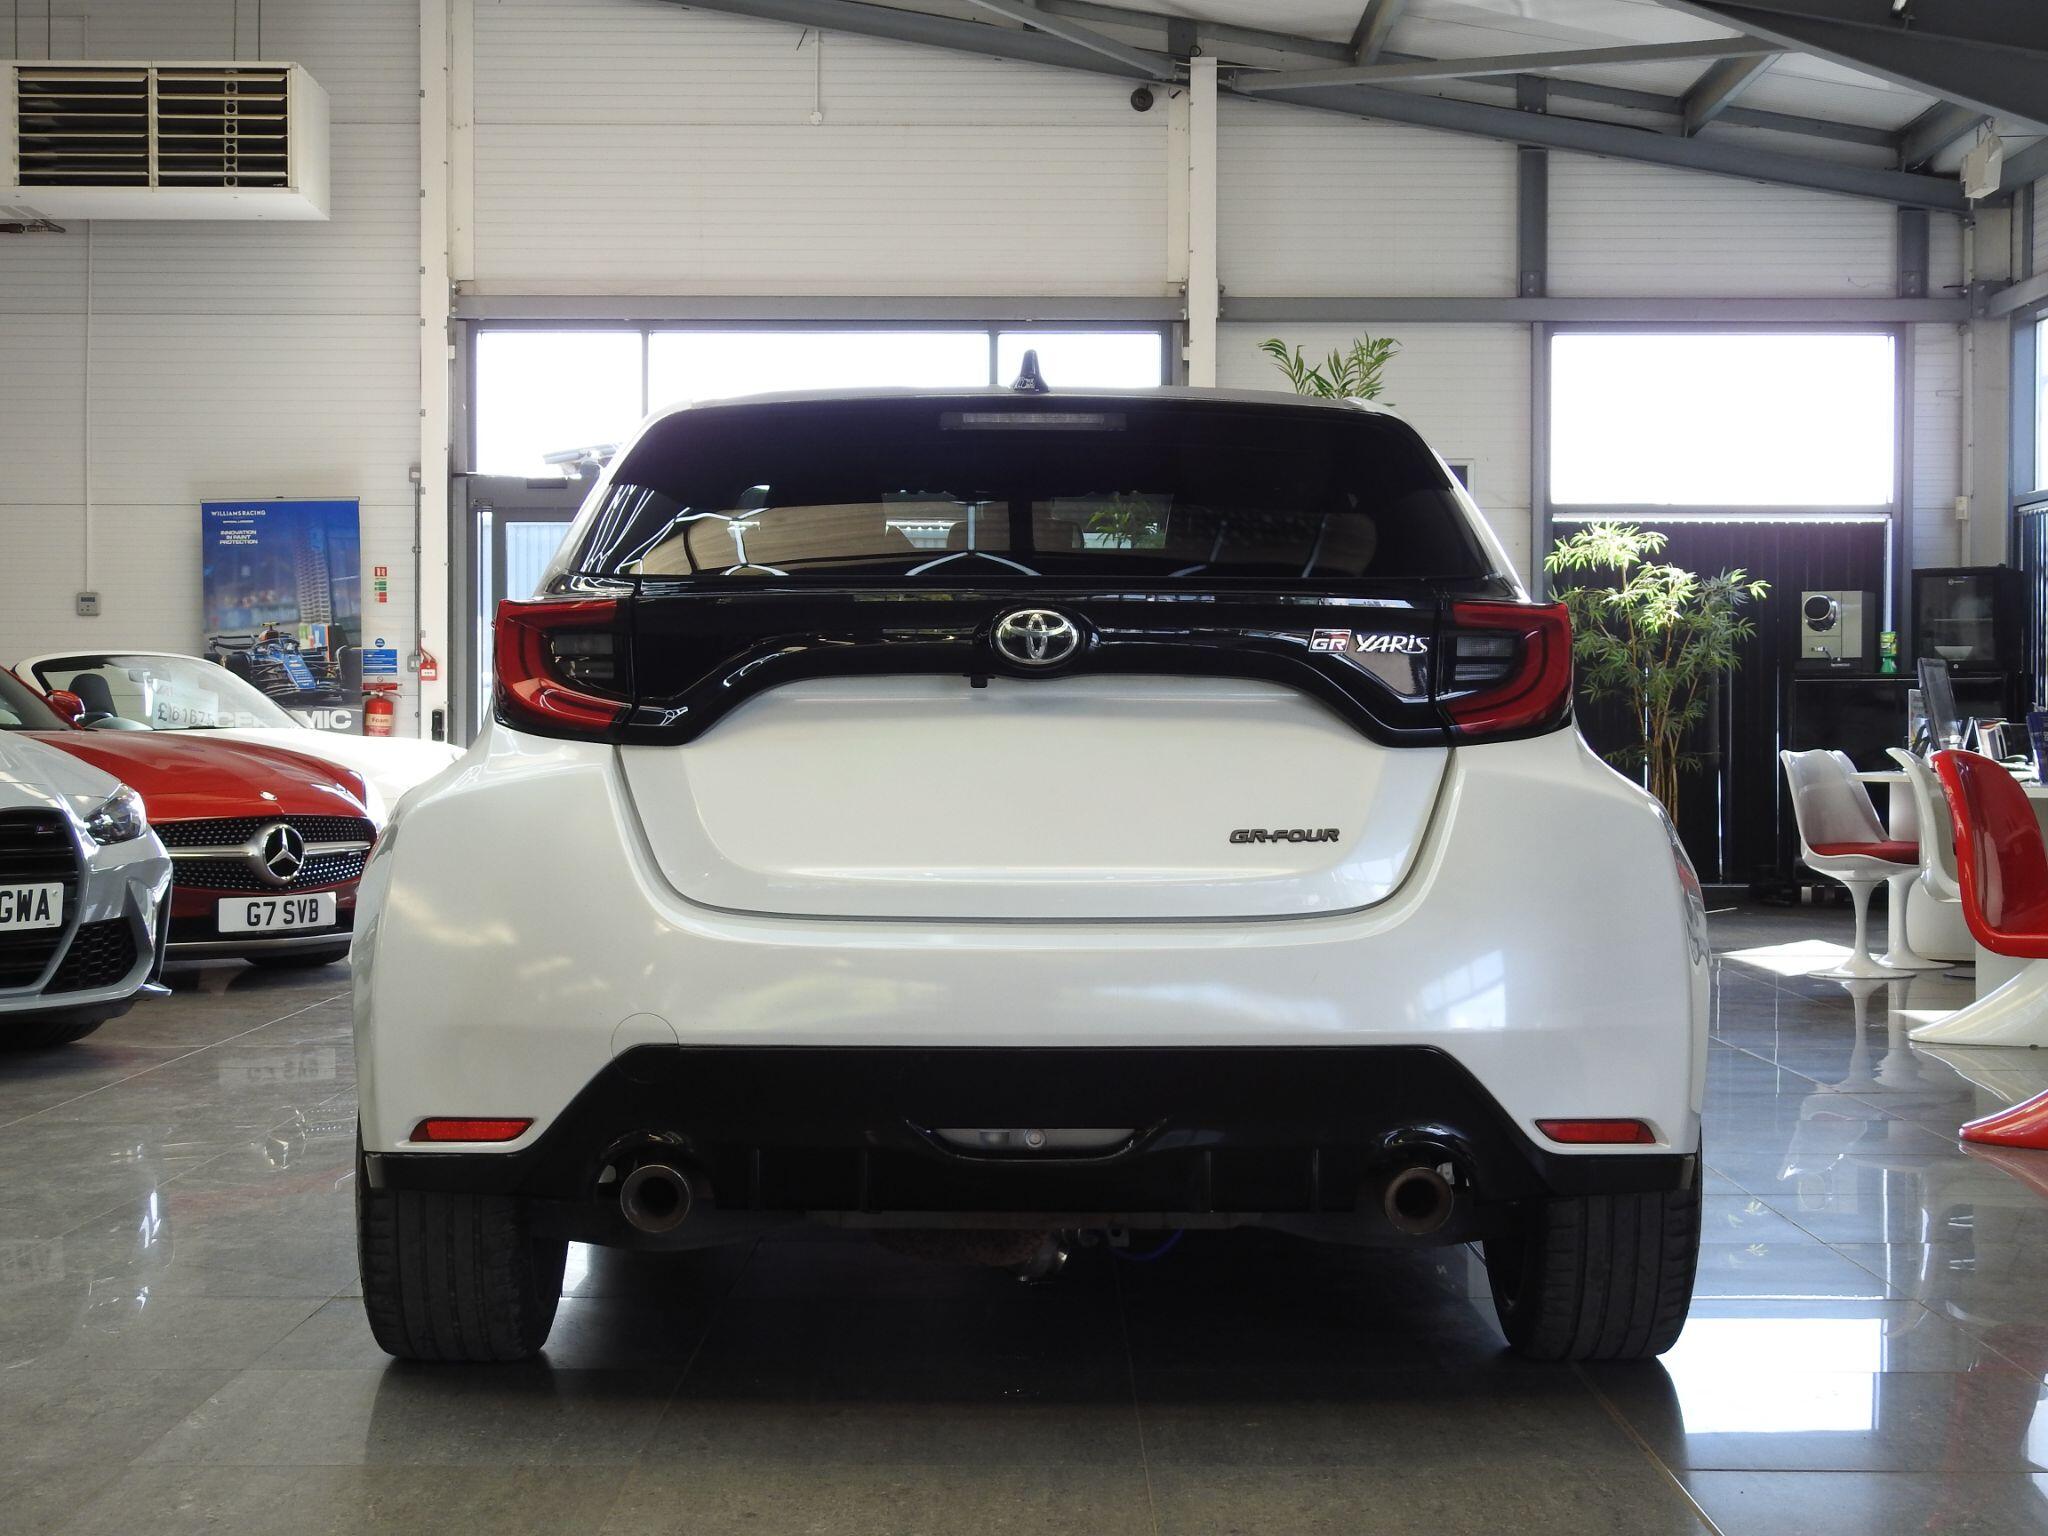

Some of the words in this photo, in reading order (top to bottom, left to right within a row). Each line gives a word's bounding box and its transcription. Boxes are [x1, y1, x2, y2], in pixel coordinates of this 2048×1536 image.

[1229, 827, 1340, 844] GR-FOUR
[0, 888, 50, 923] GWA
[247, 901, 277, 926] G7
[283, 898, 319, 925] SVB
